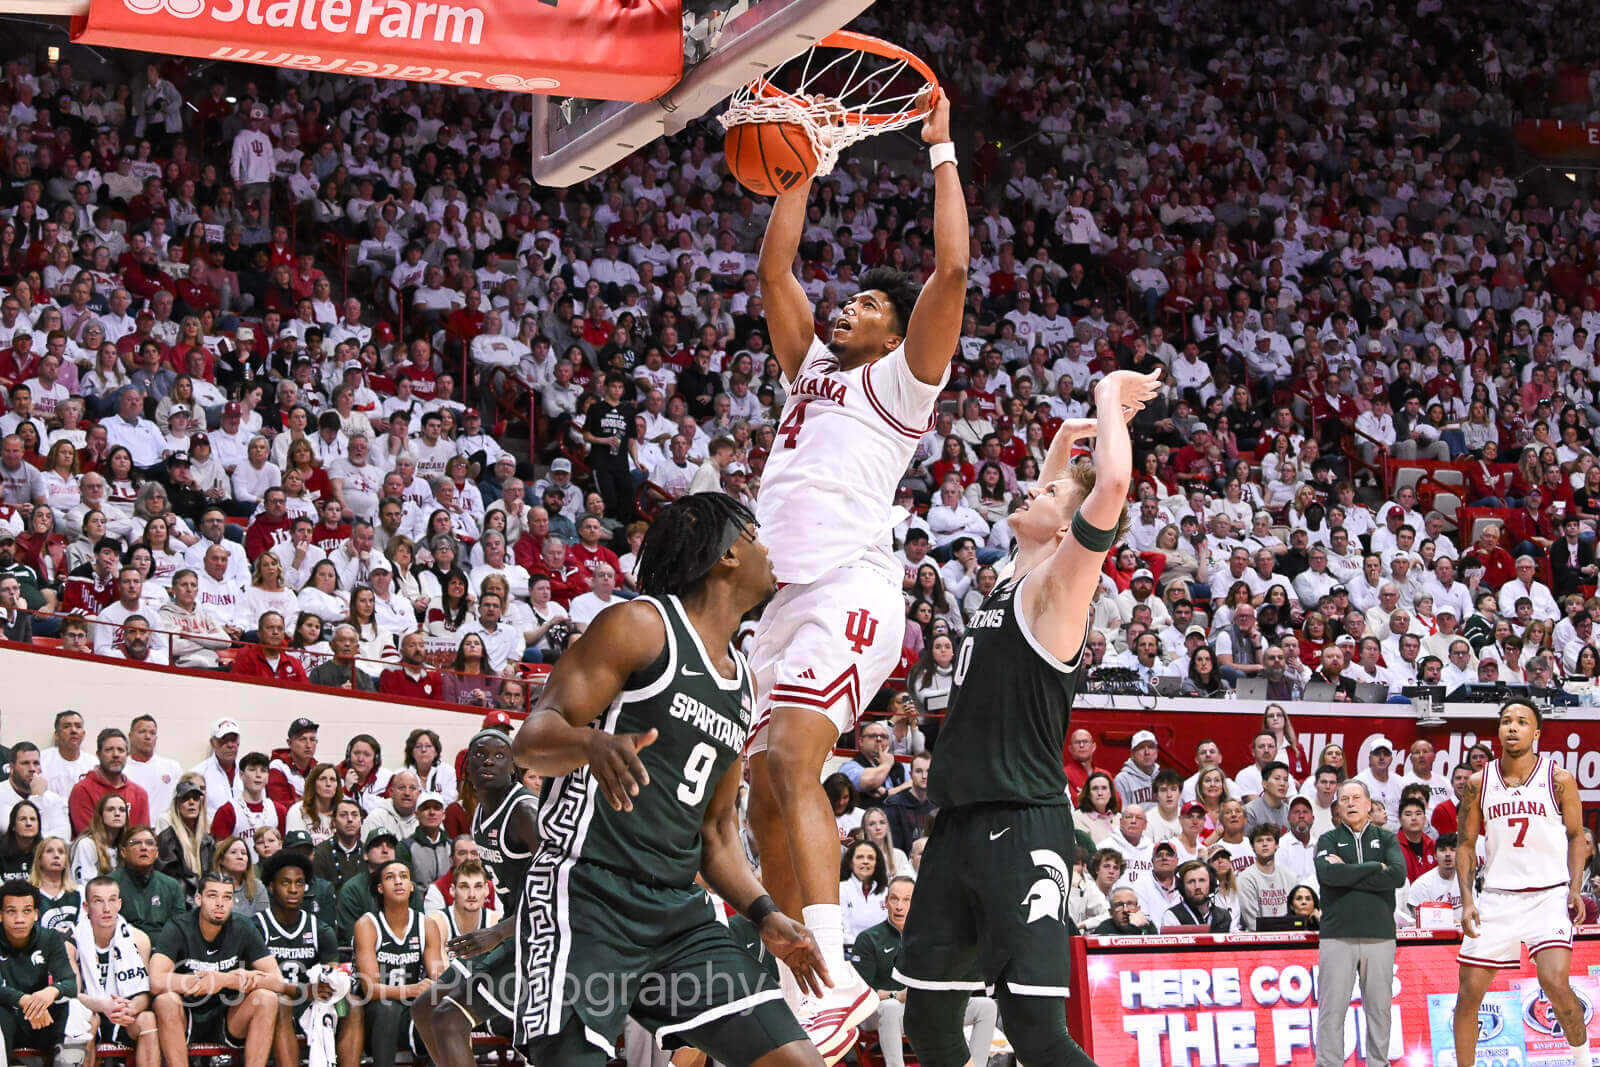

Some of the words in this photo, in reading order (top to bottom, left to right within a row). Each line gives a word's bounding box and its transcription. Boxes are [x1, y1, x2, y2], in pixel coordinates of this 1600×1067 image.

[778, 399, 813, 449] 4
[669, 692, 748, 755] SPARTANS
[677, 741, 717, 807] 9
[1488, 801, 1548, 820] INDIANA
[1507, 818, 1530, 848] 7
[1145, 935, 1178, 945] American
[1119, 968, 1242, 1009] HERE
[1122, 1009, 1260, 1067] THE
